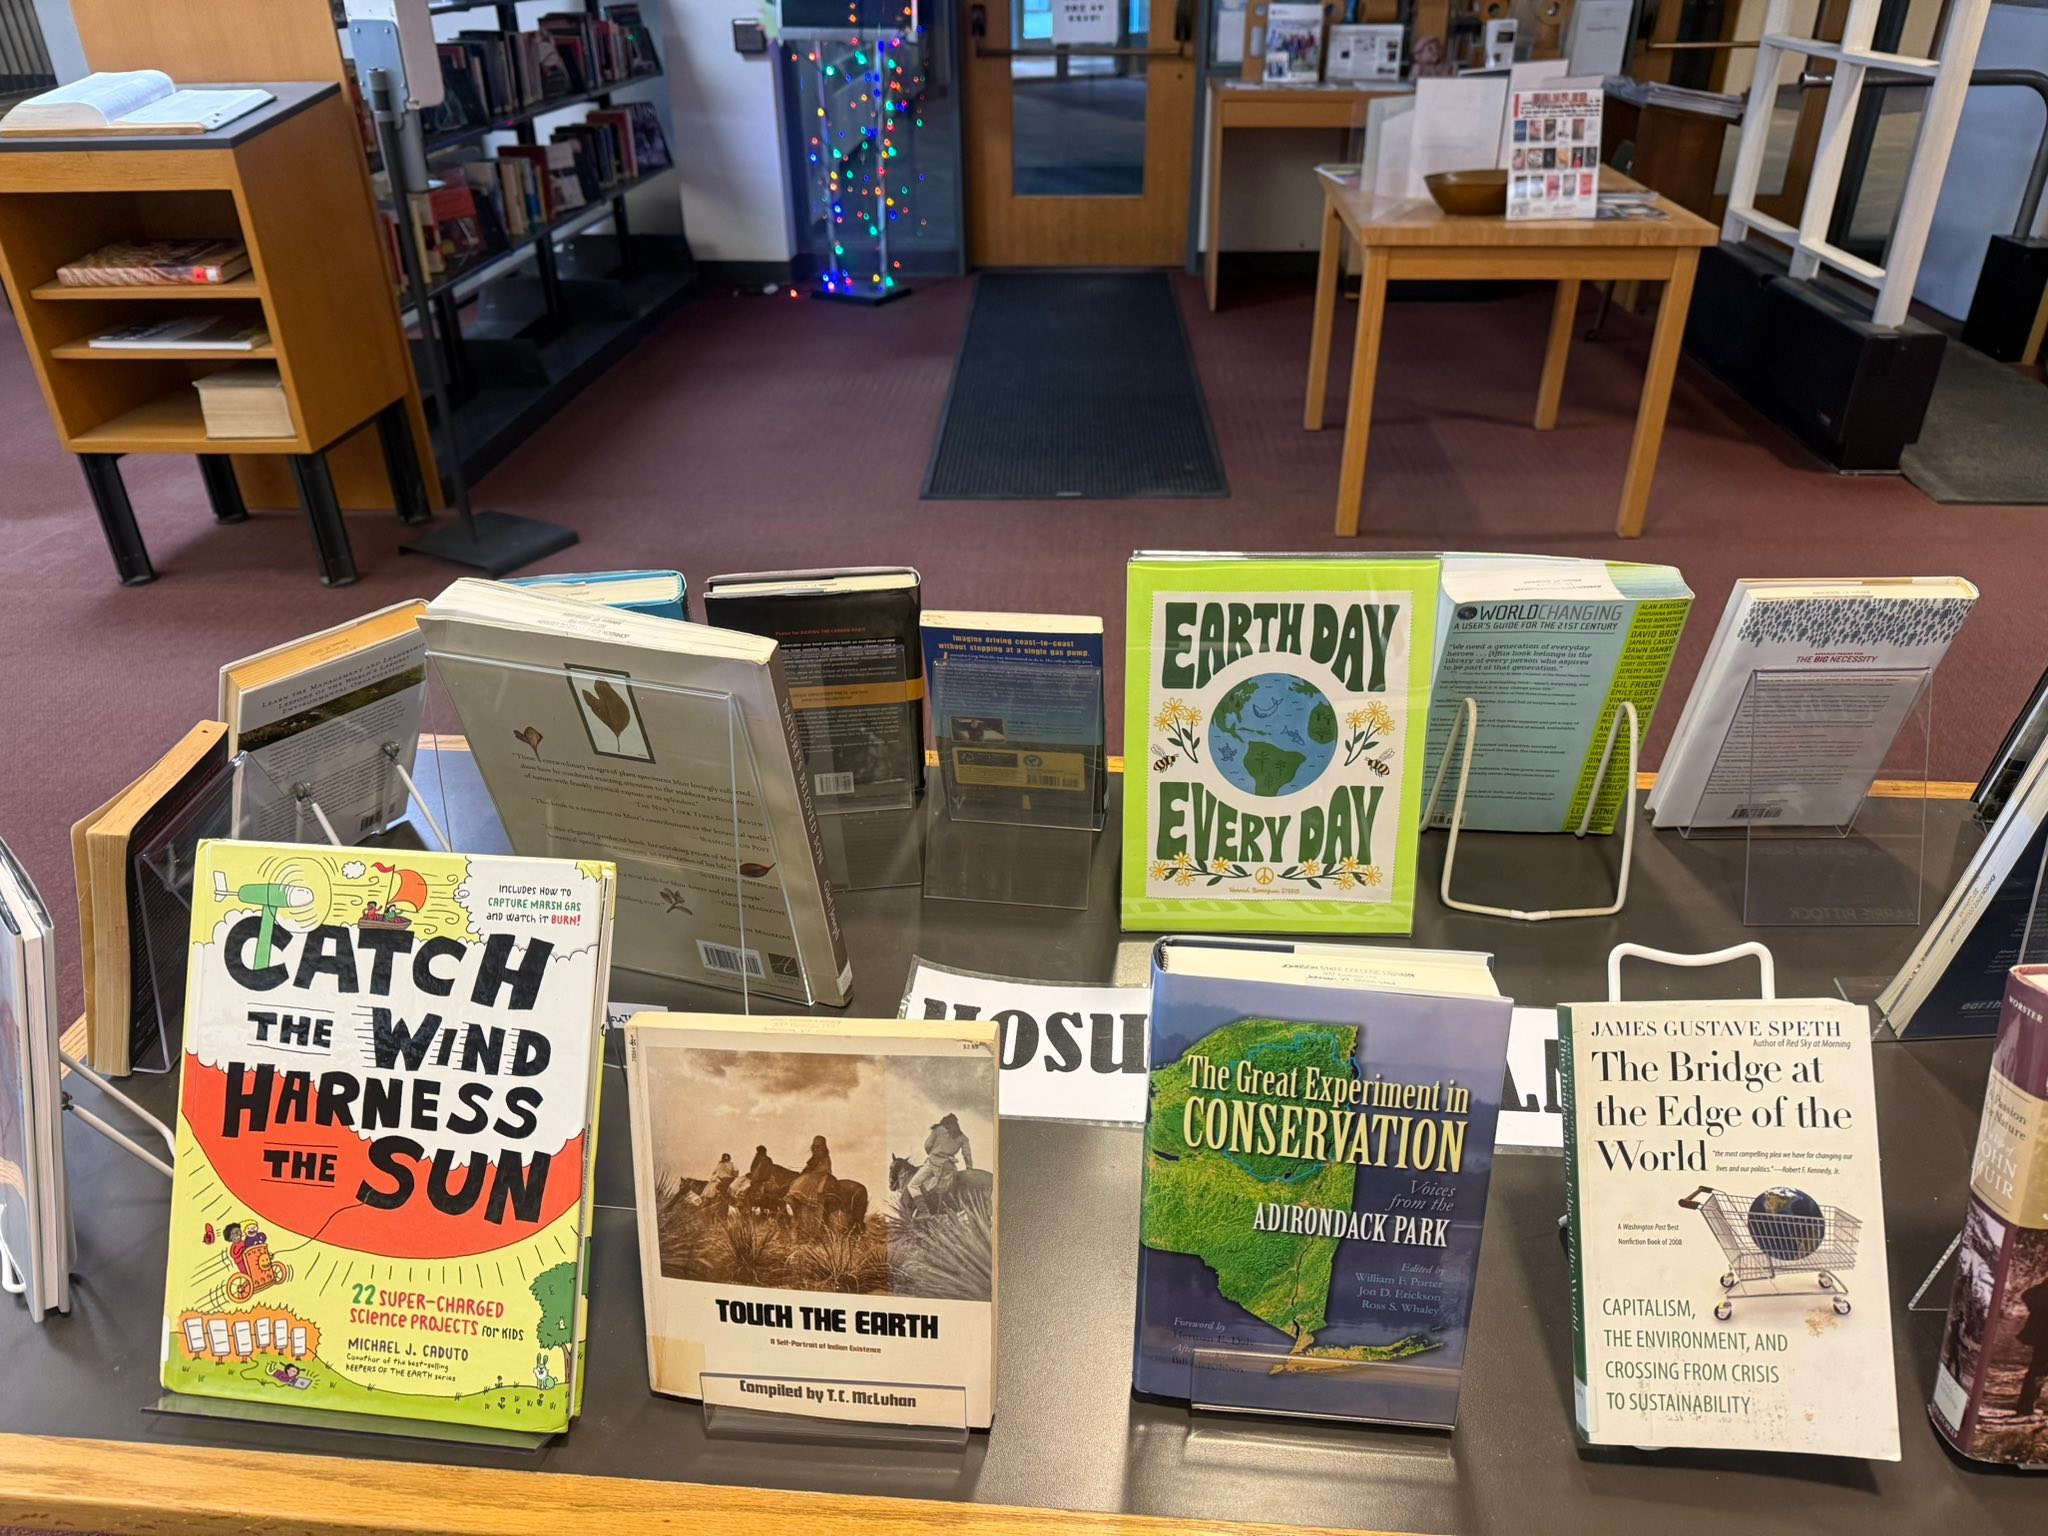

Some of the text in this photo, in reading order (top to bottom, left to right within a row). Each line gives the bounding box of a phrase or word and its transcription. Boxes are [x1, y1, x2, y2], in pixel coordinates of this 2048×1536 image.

[1480, 604, 1623, 621] WORLDCHANGING
[1580, 622, 1618, 630] CENTURY
[1659, 629, 1679, 637] BRIN
[953, 635, 1073, 647] Imagine driving coast-to-coast
[970, 645, 1002, 653] stopping
[1025, 648, 1047, 656] single
[1162, 602, 1304, 689] EARTH
[1309, 603, 1400, 692] DAY
[1630, 680, 1661, 688] FRIEND
[783, 698, 824, 865] NATURE'S BELOVED SON
[1156, 781, 1383, 865] EVERY DAY
[540, 887, 558, 895] HOW
[488, 898, 581, 911] CAPTURE MARSH GAS
[551, 915, 581, 926] BURN!
[224, 916, 554, 1010] CATCH
[2009, 995, 2043, 1023] WORSTER
[924, 998, 1147, 1073] osu
[1592, 1021, 1840, 1037] JAMES GUSTAVE SPETH
[248, 1006, 551, 1076] THE WIND
[1753, 1039, 1776, 1047] Author
[1777, 1039, 1785, 1047] of
[1801, 1040, 1812, 1049] Sky
[1822, 1040, 1851, 1049] Morning
[1592, 1050, 1659, 1082] The
[1668, 1050, 1781, 1092] Bridge
[1792, 1057, 1824, 1083] at
[1188, 1055, 1469, 1113] The Great Experiment in
[222, 1062, 543, 1138] HARNESS
[1995, 1094, 2026, 1125] Passion
[1595, 1095, 1852, 1137] the Edge of the
[1994, 1111, 2026, 1140] Nature
[1184, 1096, 1468, 1172] CONSERVATION
[1595, 1140, 1709, 1171] World
[1739, 1151, 1768, 1159] compelling
[264, 1135, 550, 1224] THE SUN
[1410, 1180, 1455, 1197] Voices
[1386, 1194, 1454, 1212] from the
[1253, 1202, 1449, 1247] ADIRONDACK PARK
[1623, 1224, 1654, 1232] Washington
[1356, 1272, 1442, 1288] William F. Porter
[1402, 1263, 1445, 1276] Edited by
[352, 1283, 504, 1318] 22 SUPER-CHARGED
[1356, 1286, 1441, 1301] Jon D. Erickson
[716, 1299, 938, 1339] TOUCH THE EARTH
[1362, 1300, 1439, 1316] Ross S. Whaley
[1603, 1299, 1695, 1319] CAPITALISM,
[411, 1314, 478, 1336] PROJECTS
[502, 1328, 524, 1341] KIDS
[1174, 1317, 1214, 1330] Foreword
[348, 1338, 468, 1361] MICHAEL J. CADUTO
[777, 1339, 818, 1349] Self-Portrait
[827, 1343, 848, 1351] Indian
[850, 1345, 881, 1354] Existence
[1604, 1329, 1787, 1352] THE ENVIRONMENT, AND
[346, 1364, 376, 1373] KEEPERS
[378, 1366, 387, 1374] OF
[391, 1367, 405, 1376] THE
[407, 1370, 433, 1379] EARTH
[1606, 1361, 1779, 1383] CROSSING FROM CRISIS
[740, 1380, 916, 1407] Compiled by T.C. McLuhan
[1607, 1392, 1750, 1414] TO SUSTAINABILITY
